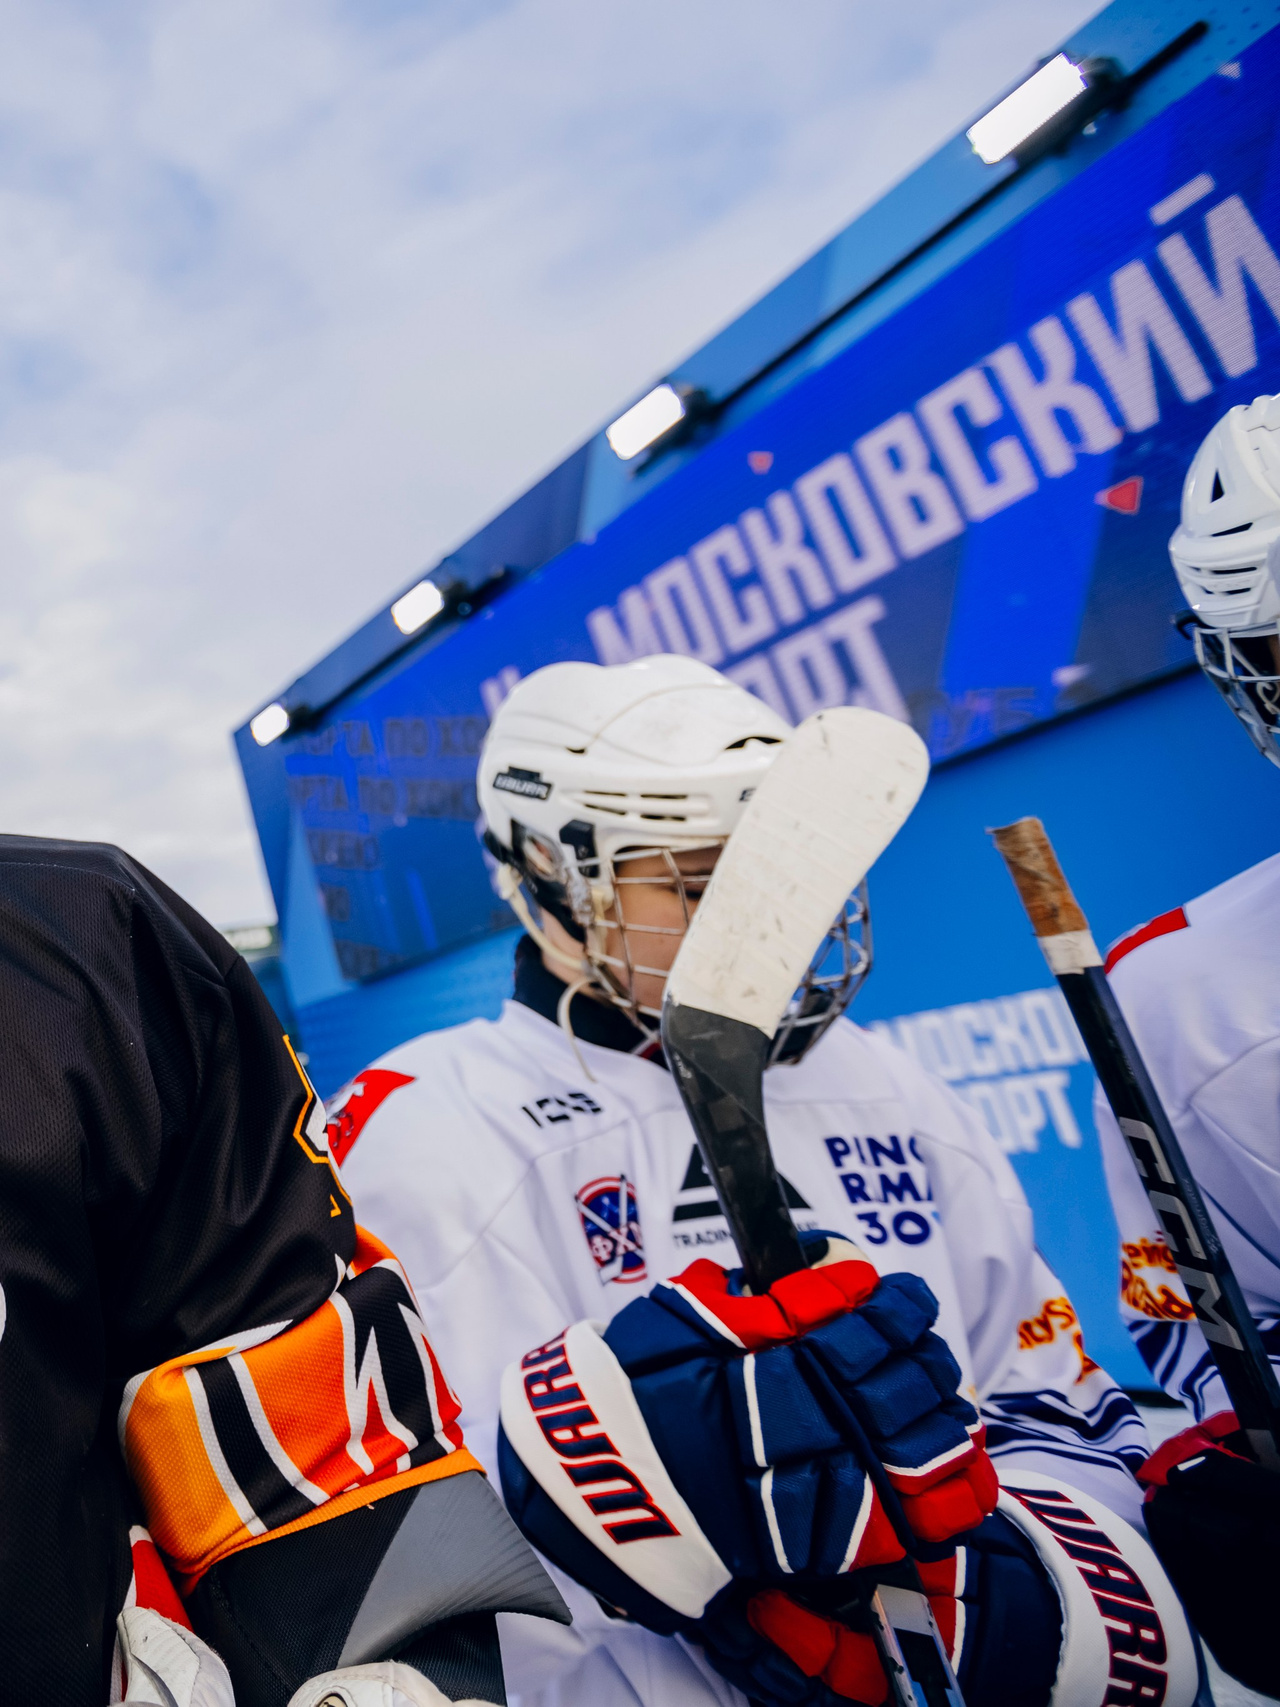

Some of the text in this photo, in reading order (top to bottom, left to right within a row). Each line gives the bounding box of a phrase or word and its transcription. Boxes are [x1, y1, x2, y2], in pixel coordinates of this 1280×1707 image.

[586, 172, 1280, 665] МОСКОВСКИЙ
[1119, 1116, 1245, 1351] CCM
[520, 1326, 682, 1545] WARR
[998, 1484, 1169, 1707] WARR
